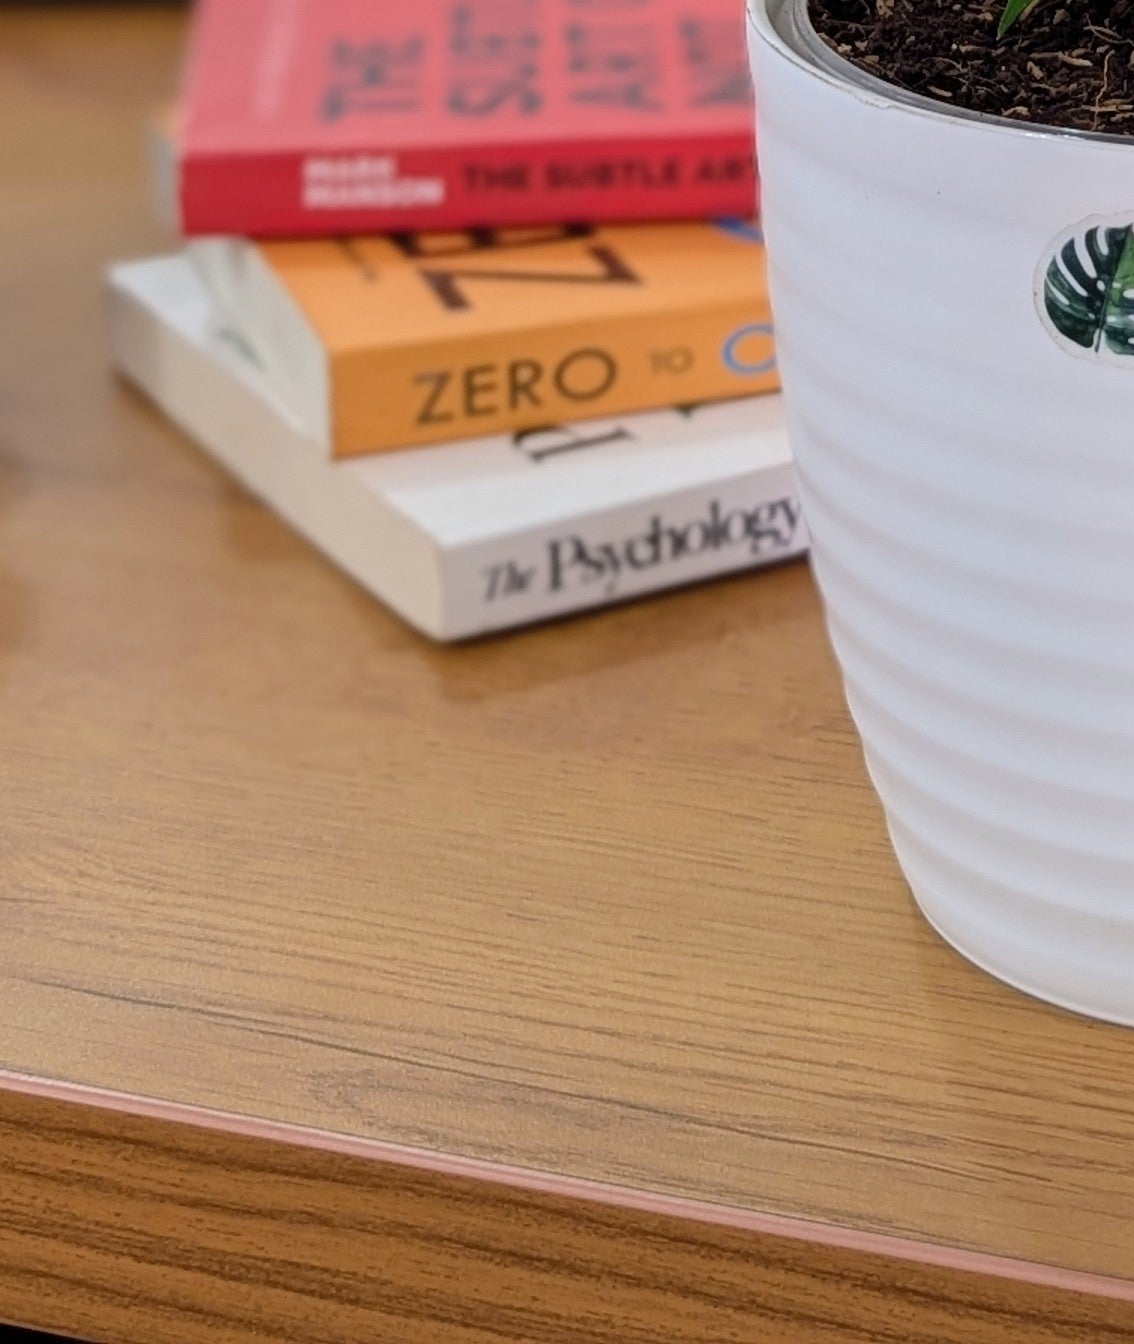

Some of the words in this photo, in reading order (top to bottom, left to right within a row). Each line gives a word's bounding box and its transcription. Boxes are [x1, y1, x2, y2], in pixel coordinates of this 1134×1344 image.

[463, 162, 530, 191] THE
[546, 157, 680, 188] SUBTLE
[414, 347, 617, 425] ZERO
[649, 346, 694, 375] TO
[482, 558, 537, 602] The
[547, 496, 800, 596] Psychology
